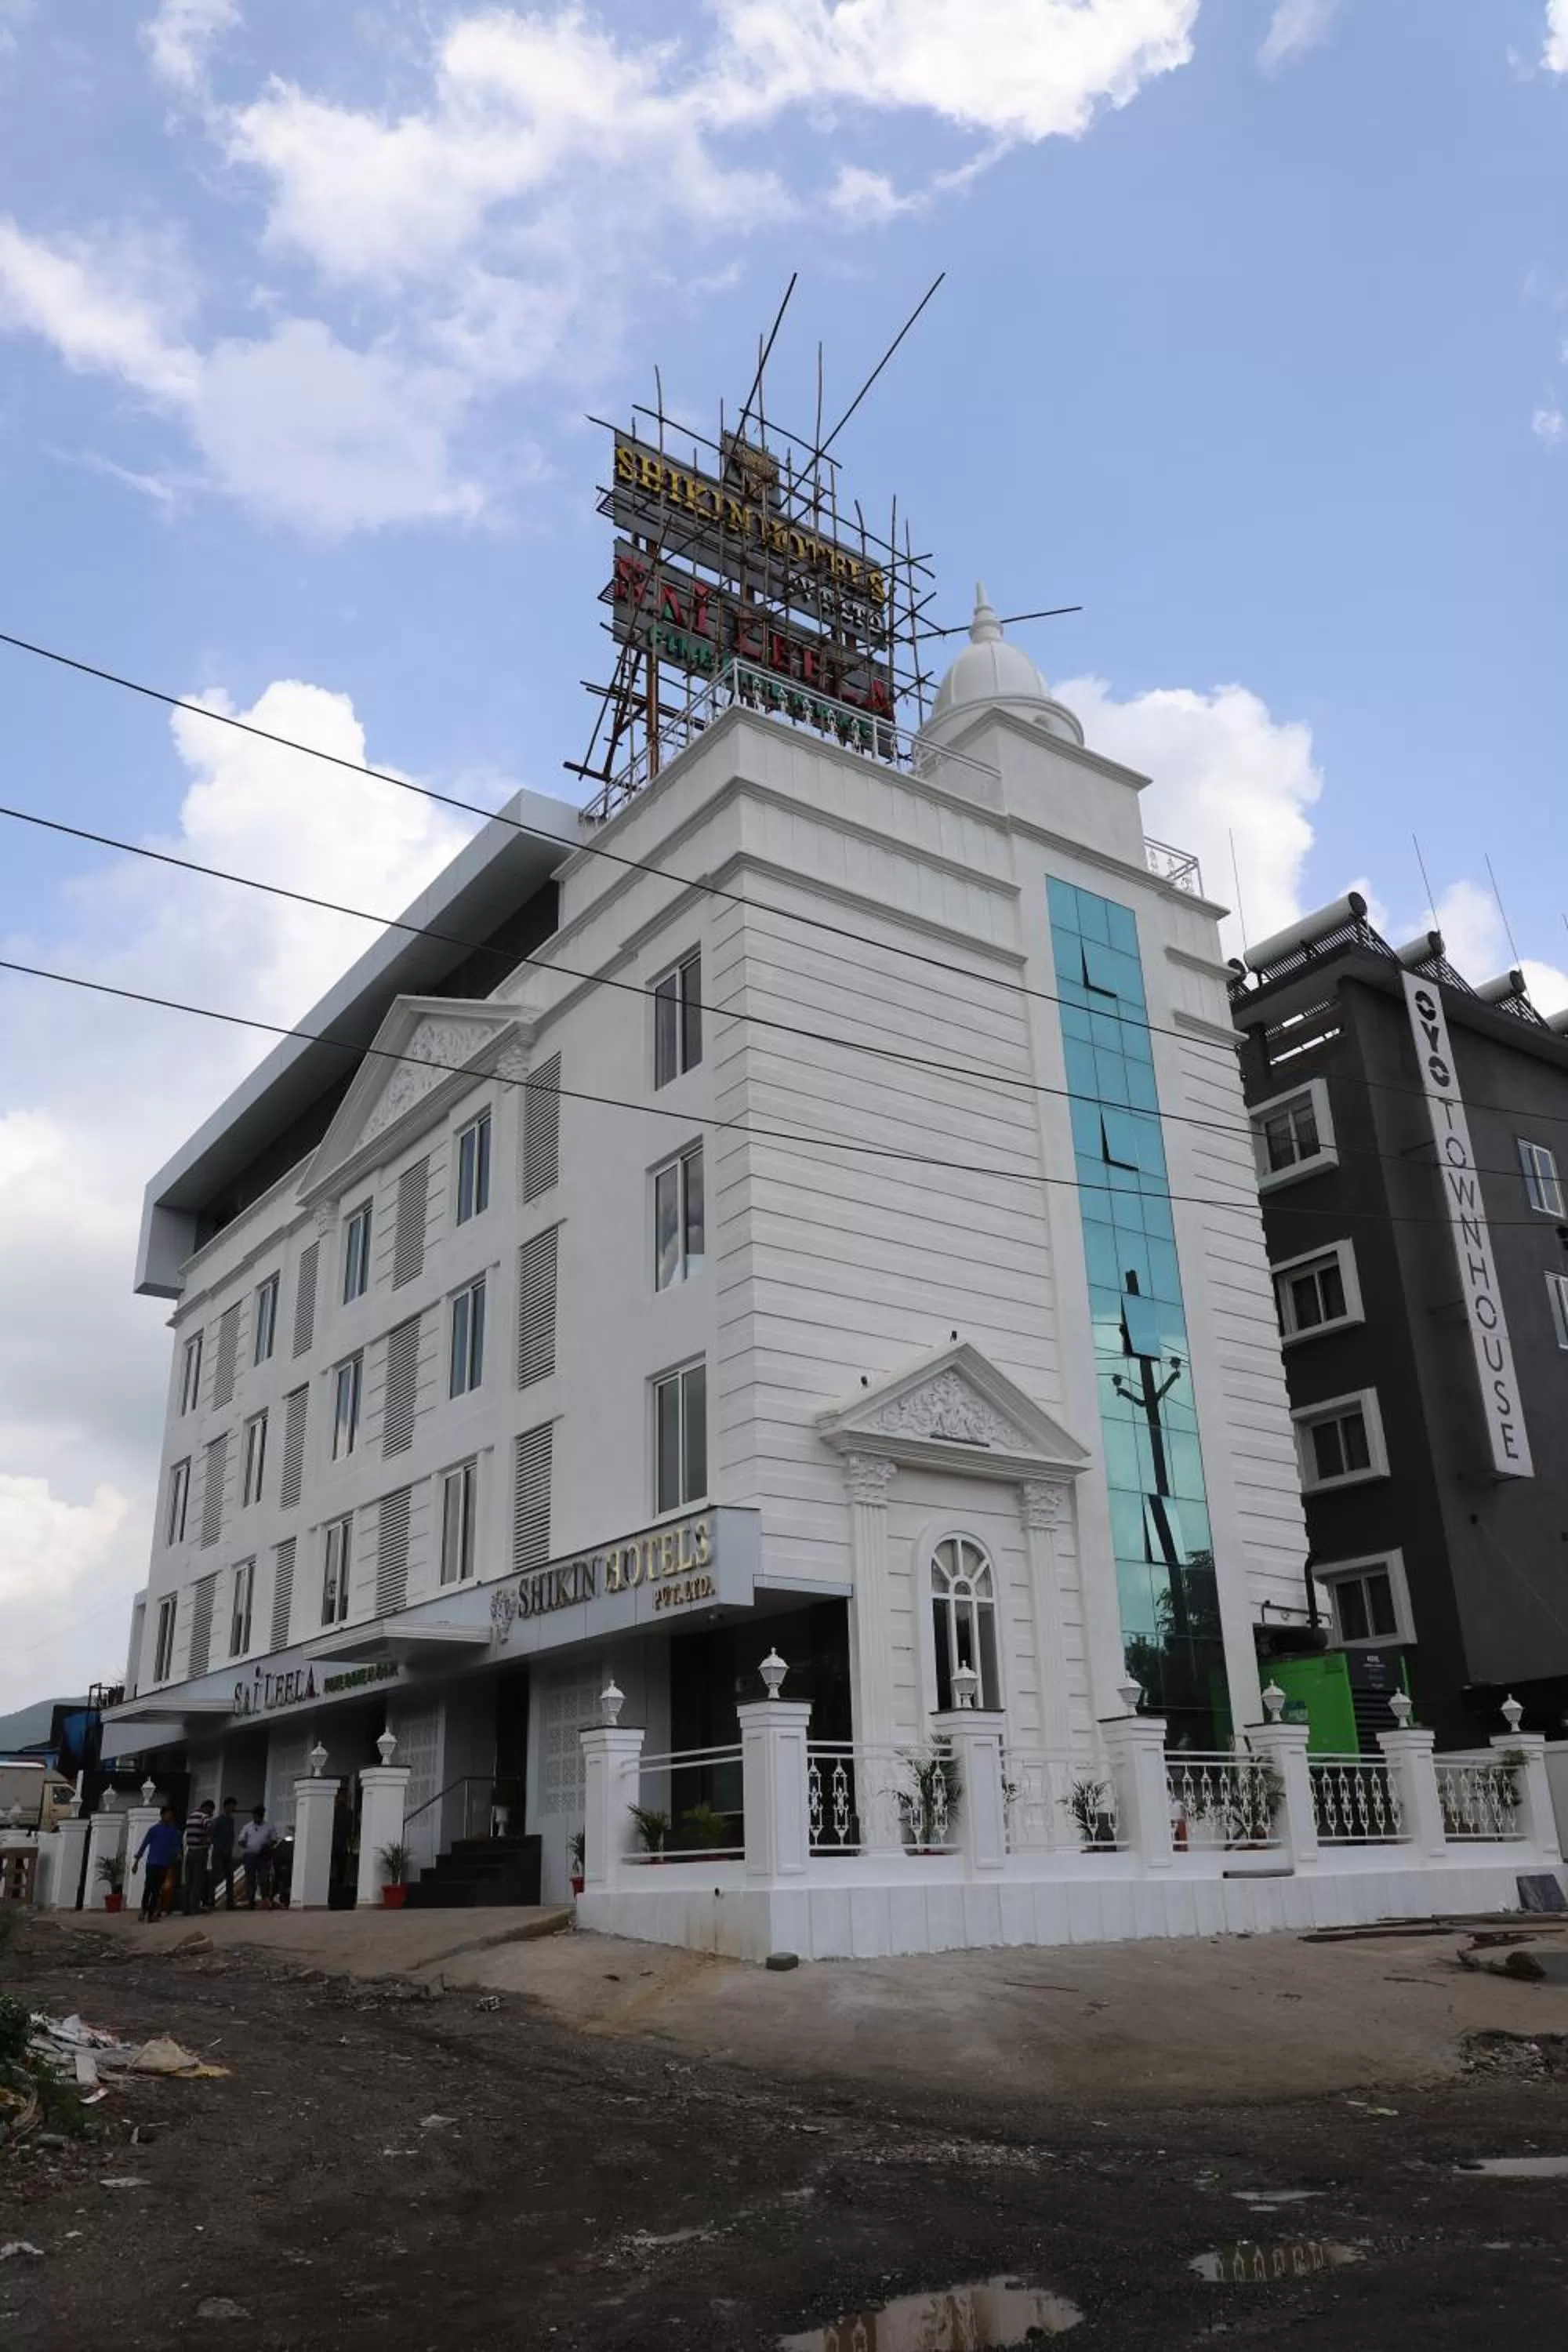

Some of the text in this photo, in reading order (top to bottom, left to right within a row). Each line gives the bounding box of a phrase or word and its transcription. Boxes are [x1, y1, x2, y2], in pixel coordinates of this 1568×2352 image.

[615, 446, 885, 602] SHIKIN HOTELS
[1414, 990, 1519, 1460] OYO TOWNHOUSE
[517, 1519, 713, 1619] SHIKIN HOTELS
[234, 1664, 263, 1715] SAI
[264, 1664, 320, 1711] LEELA
